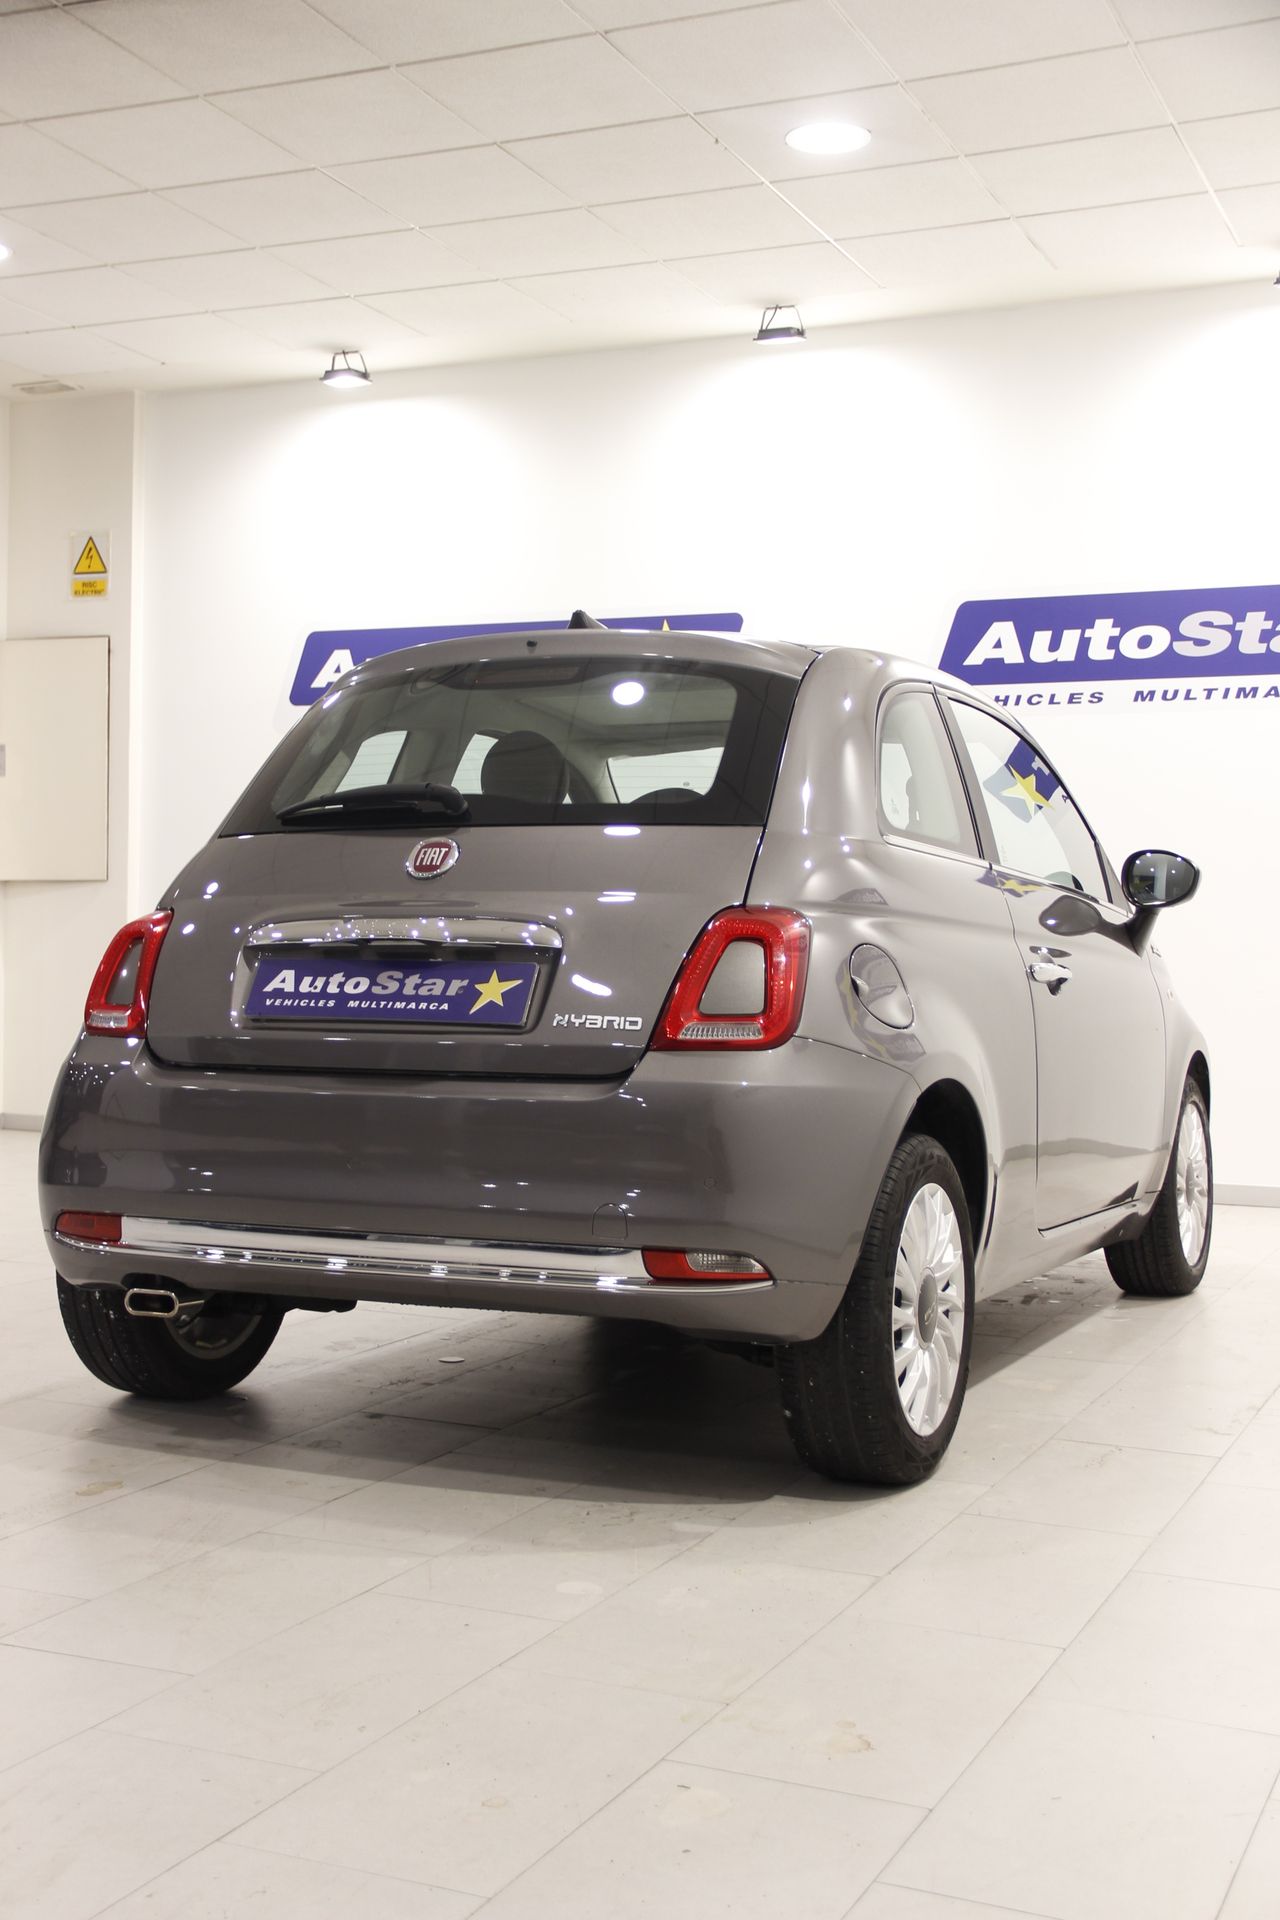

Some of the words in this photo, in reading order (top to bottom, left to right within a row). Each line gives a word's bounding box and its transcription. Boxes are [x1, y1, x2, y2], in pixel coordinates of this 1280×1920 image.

[415, 847, 449, 866] FIAT
[262, 969, 469, 996] AutoStar
[265, 998, 336, 1008] VEHICLES
[347, 1000, 449, 1010] MULTIMARCA
[552, 1013, 643, 1031] HYBRID
